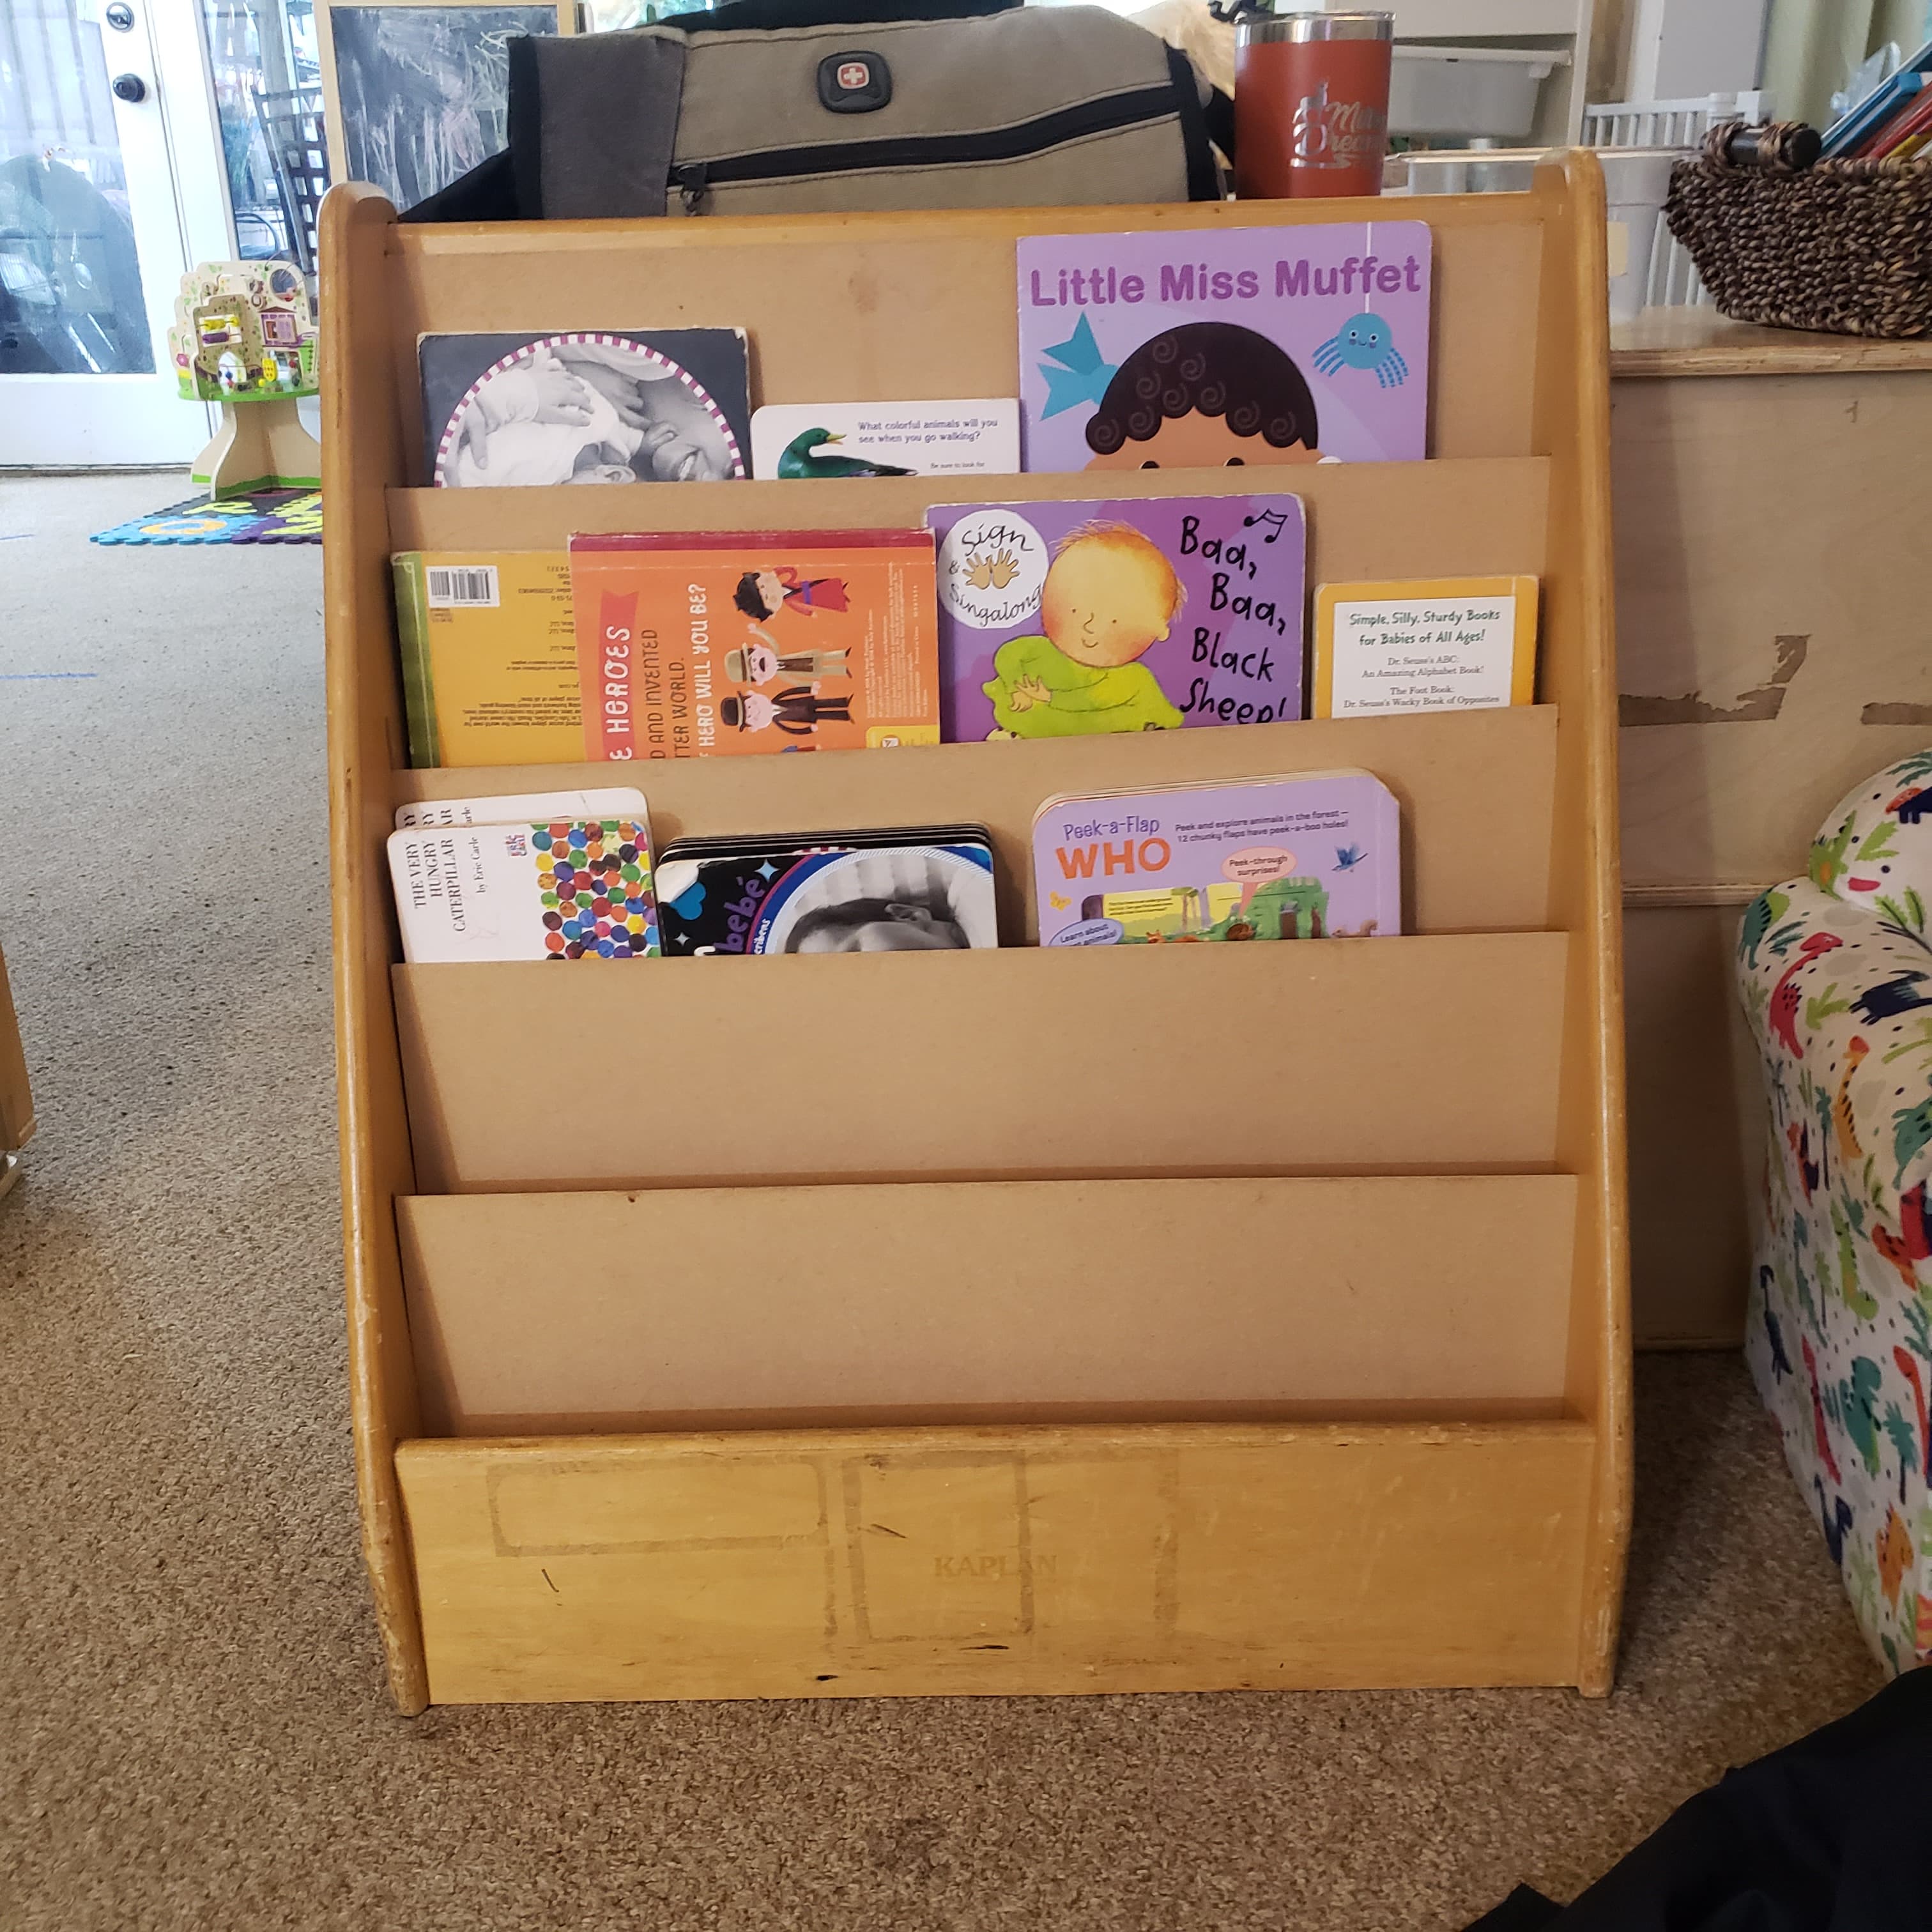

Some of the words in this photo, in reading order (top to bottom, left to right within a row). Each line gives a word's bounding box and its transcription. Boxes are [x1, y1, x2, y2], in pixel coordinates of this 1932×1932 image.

[1031, 266, 1145, 306] Little
[1160, 263, 1259, 302] Miss
[1276, 256, 1420, 296] Muffet
[858, 422, 882, 431] What
[885, 420, 921, 430] colorful
[924, 419, 960, 429] animals
[963, 418, 978, 427] will
[981, 419, 998, 429] you
[878, 434, 901, 442] when
[905, 434, 922, 443] you
[925, 434, 937, 443] go
[939, 431, 981, 442] walking?
[962, 523, 1034, 556] Sign
[1181, 516, 1257, 578] Baa,
[687, 584, 707, 614] BE?
[949, 583, 1042, 627] Singalong
[1210, 573, 1286, 635] Baa,
[1349, 613, 1390, 627] Simple,
[1392, 611, 1420, 626] Silly,
[1423, 610, 1462, 625] Sturdy
[1466, 610, 1500, 621] Books
[691, 620, 709, 655] YOU
[1360, 634, 1376, 646] for
[1381, 633, 1415, 645] Babies
[1419, 631, 1433, 643] of
[1436, 631, 1452, 643] All
[1455, 629, 1485, 645] Ages!
[641, 629, 662, 706] INVENTED
[1192, 628, 1274, 682] Black
[1402, 657, 1434, 665] Seuss's
[604, 625, 631, 733] HEROES
[693, 661, 712, 698] WILL
[1377, 669, 1416, 678] Amazing
[1417, 667, 1457, 677] Alphabet
[669, 657, 687, 719] WORLD.
[1359, 699, 1390, 707] Seuss's
[1392, 698, 1422, 707] Wacky
[1423, 696, 1444, 705] Book
[1457, 696, 1500, 705] Opposites
[1409, 686, 1429, 694] Foot
[648, 713, 666, 743] AND
[696, 705, 716, 746] HERO
[461, 807, 472, 824] arle
[1063, 815, 1160, 841] Peek-a-Flap
[1215, 818, 1248, 829] explore
[1250, 815, 1284, 825] animals
[1296, 812, 1310, 820] the
[1312, 810, 1340, 819] forest
[1177, 834, 1188, 843] 12
[1190, 831, 1222, 841] chunky
[1223, 828, 1245, 839] flaps
[1246, 827, 1268, 836] have
[1269, 824, 1321, 836] peek-a-boo
[1322, 819, 1349, 829] holes!
[405, 842, 421, 877] VERY
[468, 837, 480, 860] Carle
[1055, 837, 1171, 880] WHO
[1229, 855, 1287, 867] Peek-through
[422, 840, 442, 897] HUNGRY
[473, 863, 484, 880] Eric
[1237, 866, 1280, 877] surprises!
[411, 880, 426, 908] THE
[441, 839, 466, 931] CATERPILLAR
[475, 884, 487, 893] by
[713, 876, 765, 952] bebé
[1061, 931, 1084, 943] Learn
[1085, 924, 1109, 935] about
